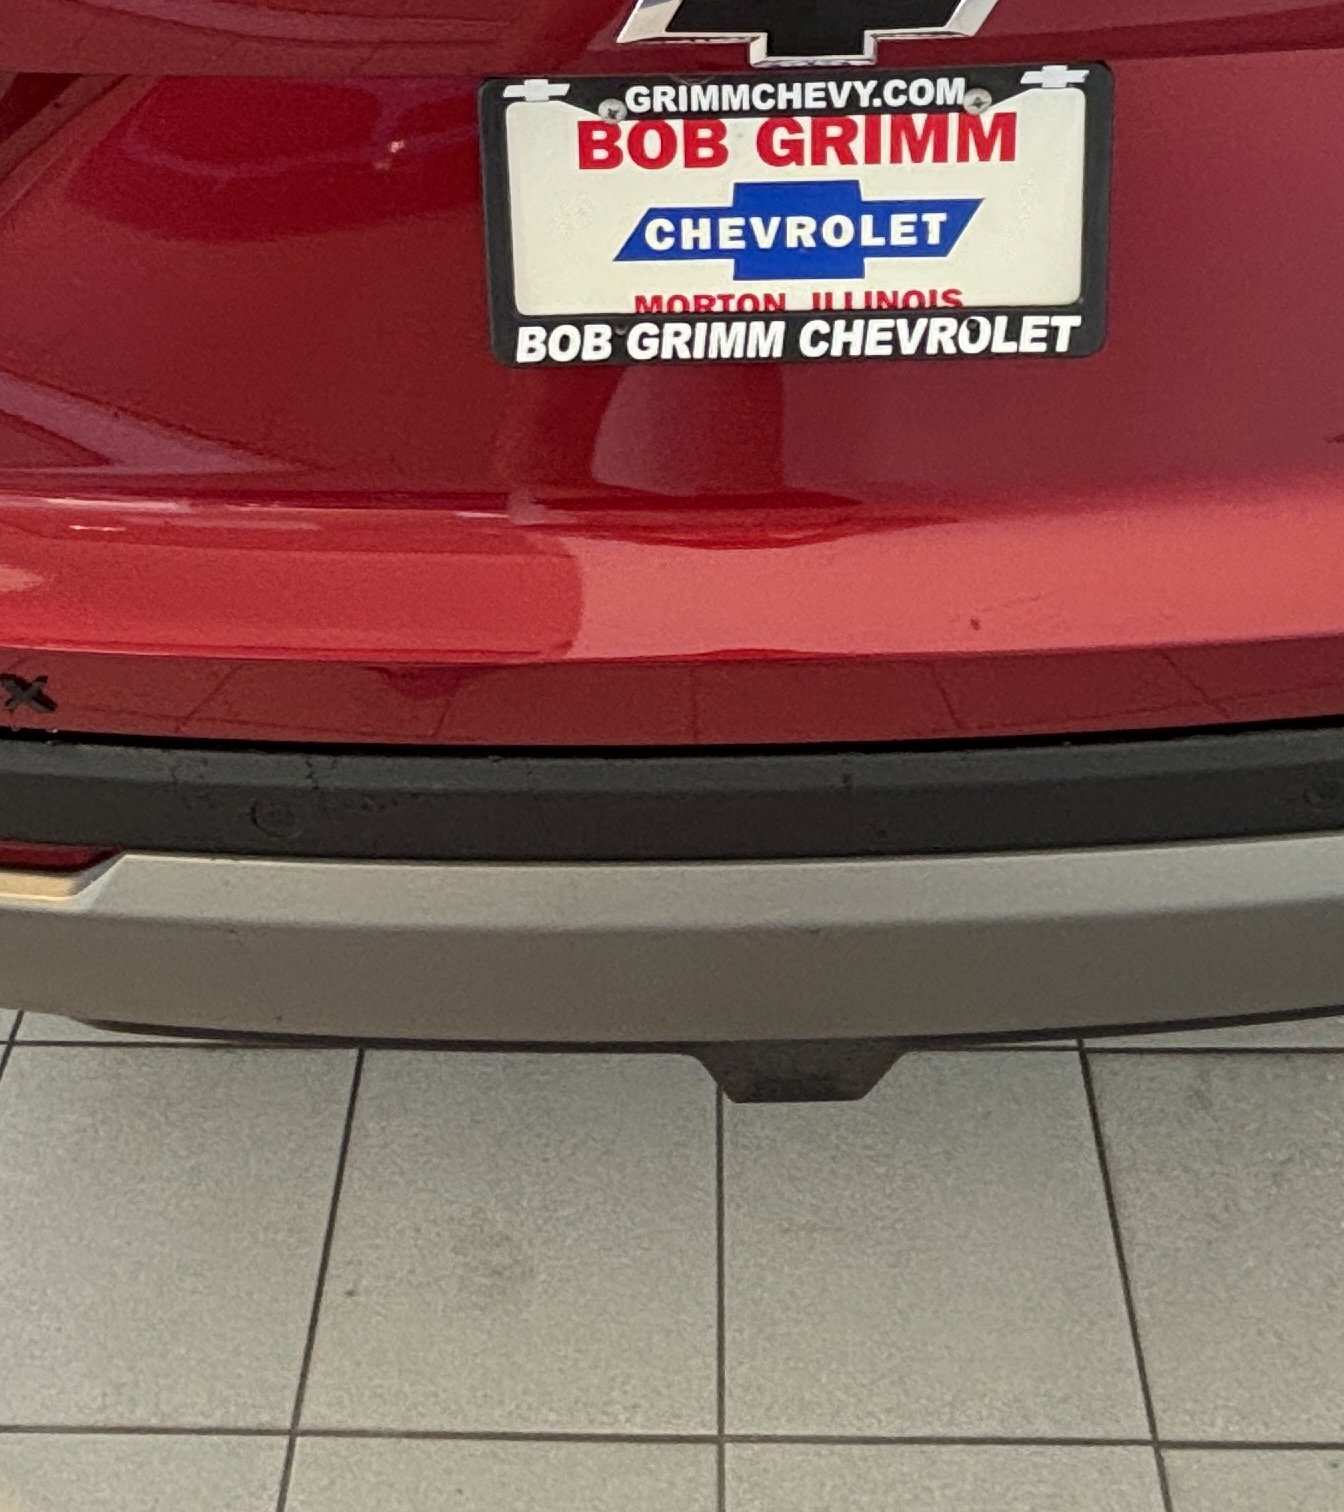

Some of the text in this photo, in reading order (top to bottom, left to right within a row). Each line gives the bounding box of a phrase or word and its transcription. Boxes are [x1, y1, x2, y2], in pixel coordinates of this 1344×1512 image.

[624, 78, 965, 113] GRIMMCHEVY.COM
[577, 112, 1017, 170] BOB GRIMM
[644, 212, 948, 250] CHEVROLET
[635, 293, 786, 313] MORTON
[516, 315, 1081, 362] BOB GRIMM CHEVROLET
